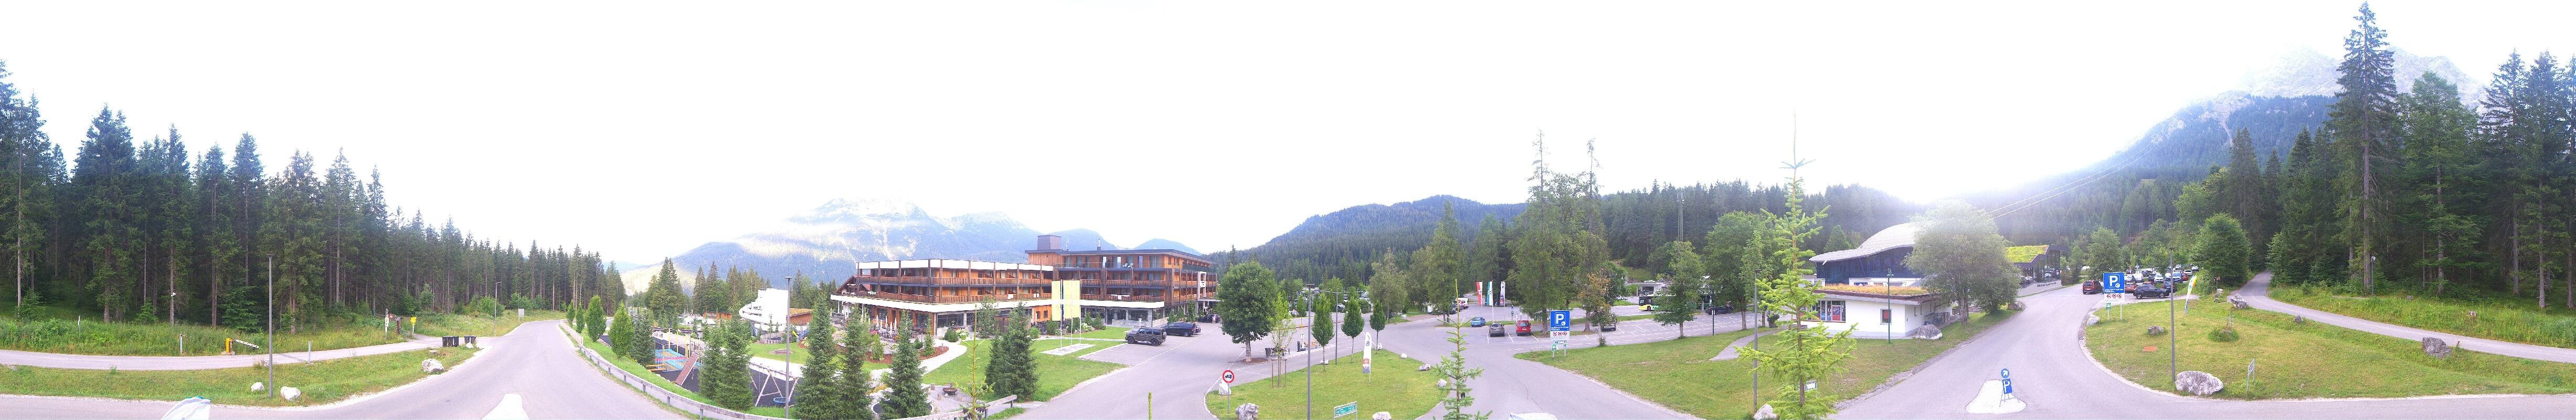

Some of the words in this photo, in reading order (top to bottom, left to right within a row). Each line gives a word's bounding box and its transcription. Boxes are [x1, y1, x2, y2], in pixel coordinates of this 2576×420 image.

[2109, 275, 2118, 287] P
[1555, 313, 1564, 324] P
[2003, 380, 2010, 393] P
